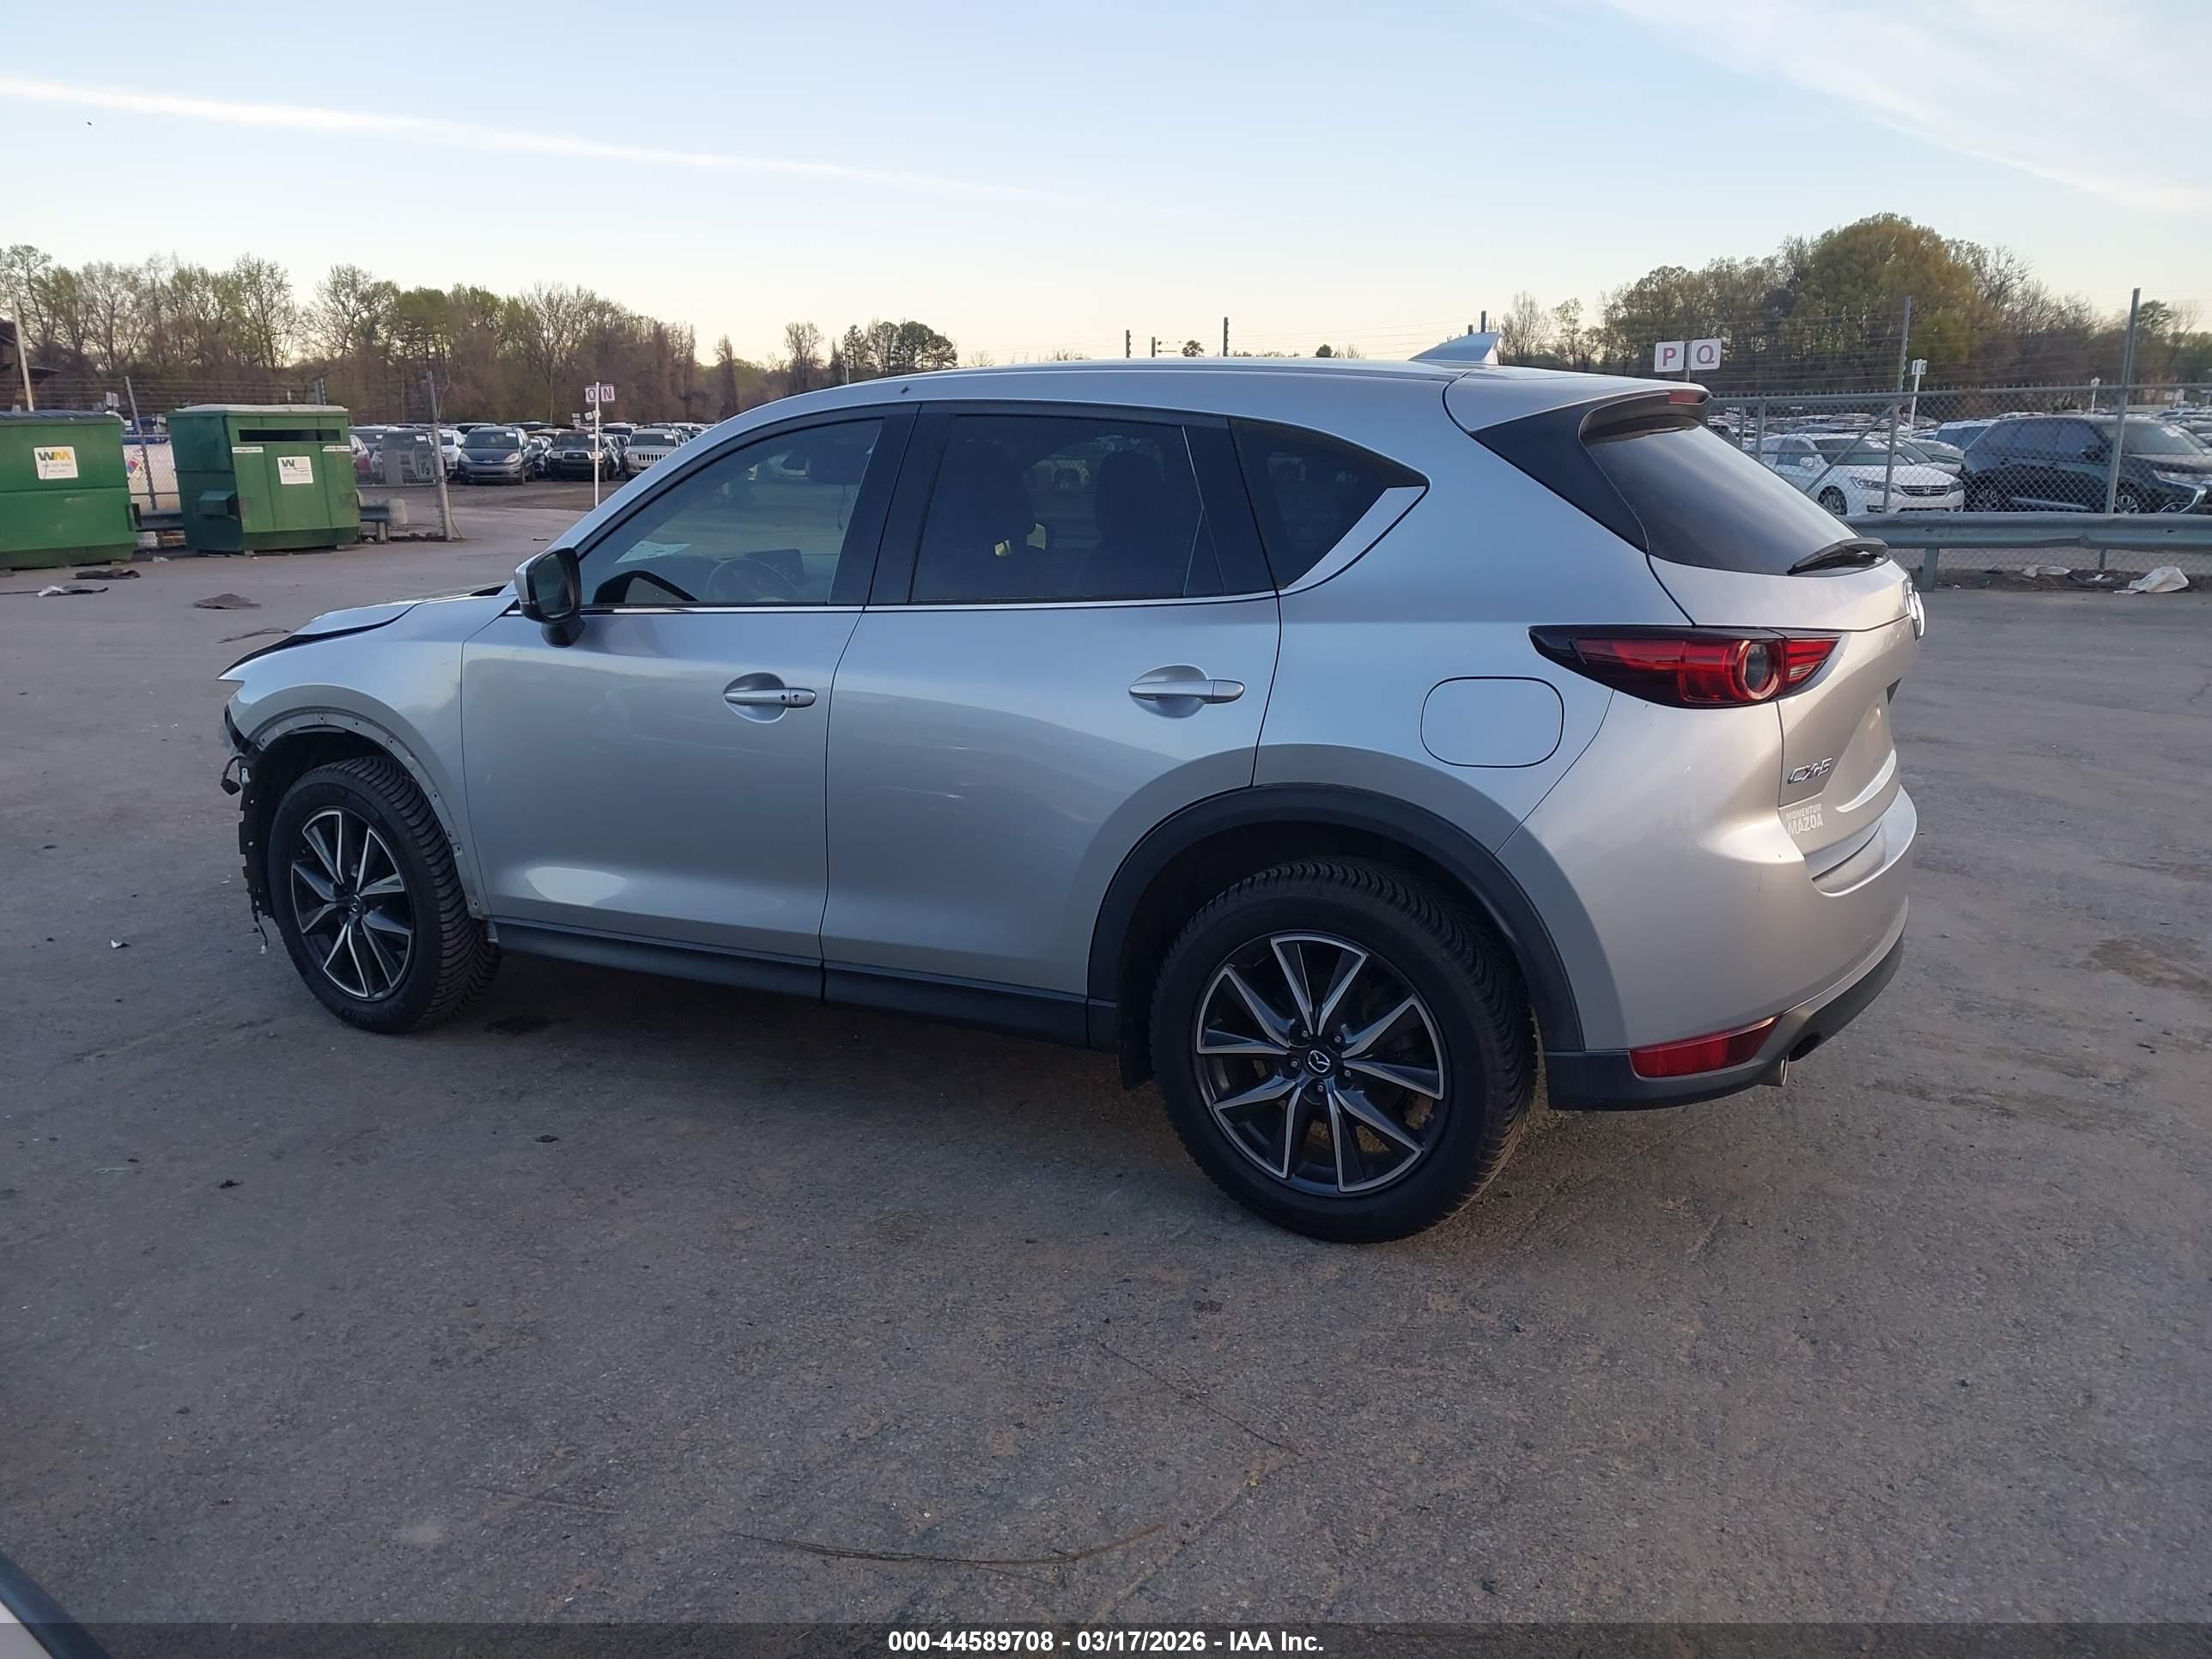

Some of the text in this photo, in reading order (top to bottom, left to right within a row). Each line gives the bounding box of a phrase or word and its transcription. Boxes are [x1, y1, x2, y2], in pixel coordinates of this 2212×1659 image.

[1662, 347, 1677, 367] P
[1696, 344, 1715, 364] Q
[603, 387, 612, 400] N
[37, 451, 70, 461] WM
[1786, 803, 1822, 821] MOMENTUM
[1788, 813, 1824, 836] MAZDA
